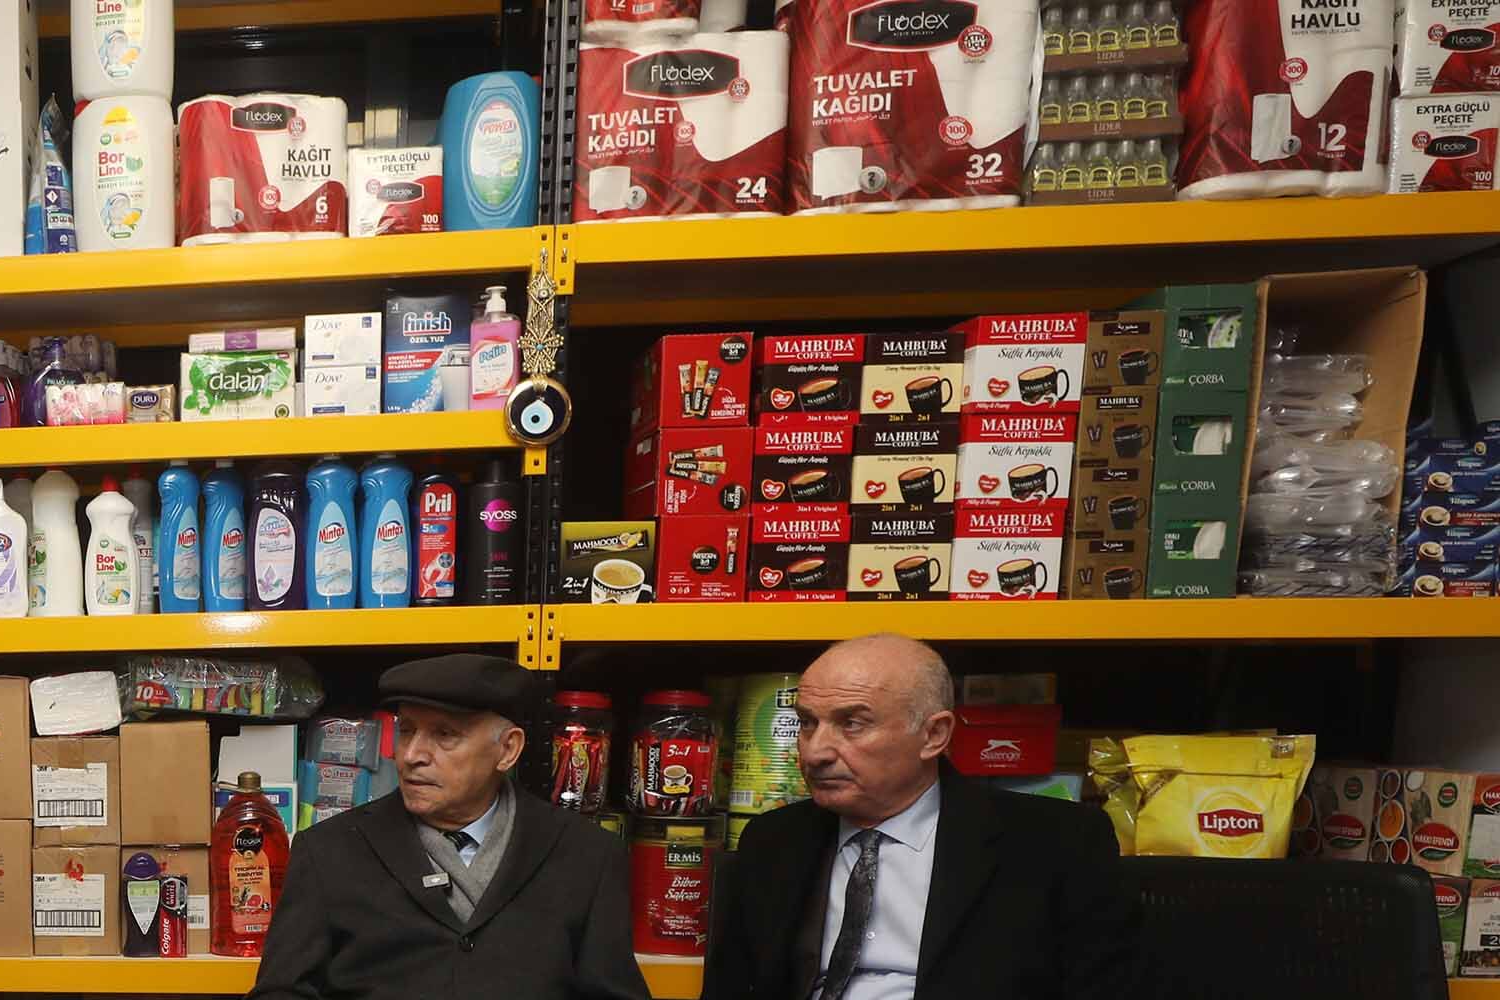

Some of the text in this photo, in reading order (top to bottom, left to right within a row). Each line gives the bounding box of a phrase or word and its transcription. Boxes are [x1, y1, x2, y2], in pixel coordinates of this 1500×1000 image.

[1448, 6, 1489, 18] PEÇETE
[1290, 12, 1361, 29] HAVLU
[813, 69, 918, 95] TUVALET
[812, 91, 893, 118] KAĞIDI
[1416, 101, 1491, 115] EXTRA GÜÇLÜ
[587, 106, 678, 132] TUVALET
[1433, 113, 1474, 125] PEÇETE
[587, 127, 656, 153] KAĞIDI
[1318, 122, 1347, 152] 12
[98, 152, 125, 166] Bor
[287, 144, 332, 162] KAĞIT
[98, 165, 124, 177] Line
[282, 163, 332, 178] HAVLU
[381, 162, 417, 173] PEÇETE
[965, 153, 1003, 178] 32
[1474, 170, 1492, 182] 100
[736, 177, 767, 199] 24
[315, 195, 329, 214] 6
[422, 213, 439, 224] 100
[313, 318, 343, 332] Dove
[402, 311, 452, 335] finish
[990, 319, 1077, 334] MAHBUBA
[408, 334, 446, 344] ÖZEL TUZ
[1013, 332, 1051, 341] COFFEE
[775, 339, 855, 353] MAHBUBA
[882, 339, 948, 352] MAHBUBA
[796, 351, 833, 360] COFFEE
[209, 371, 266, 391] dalan
[1188, 373, 1225, 386] ÇORBA
[981, 417, 1066, 432] MAHBUBA
[766, 430, 844, 445] MAHBUBA
[1003, 430, 1041, 438] COFFEE
[786, 443, 822, 452] COFFEE
[1181, 480, 1217, 491] ÇORBA
[425, 493, 453, 514] Pril
[479, 508, 518, 523] syoss
[970, 514, 1053, 527] MAHBUBA
[377, 524, 404, 541] Mintax
[763, 519, 841, 533] MAHBUBA
[318, 527, 346, 544] Mintax
[573, 536, 620, 550] MAHMOOD
[96, 553, 115, 564] Bor
[96, 563, 115, 572] Line
[1174, 584, 1210, 597] ÇORBA
[136, 686, 154, 699] 10
[667, 743, 692, 758] 3in1
[980, 750, 1022, 763] Slazenger
[1203, 813, 1260, 834] Lipton
[162, 918, 171, 955] Colgate
